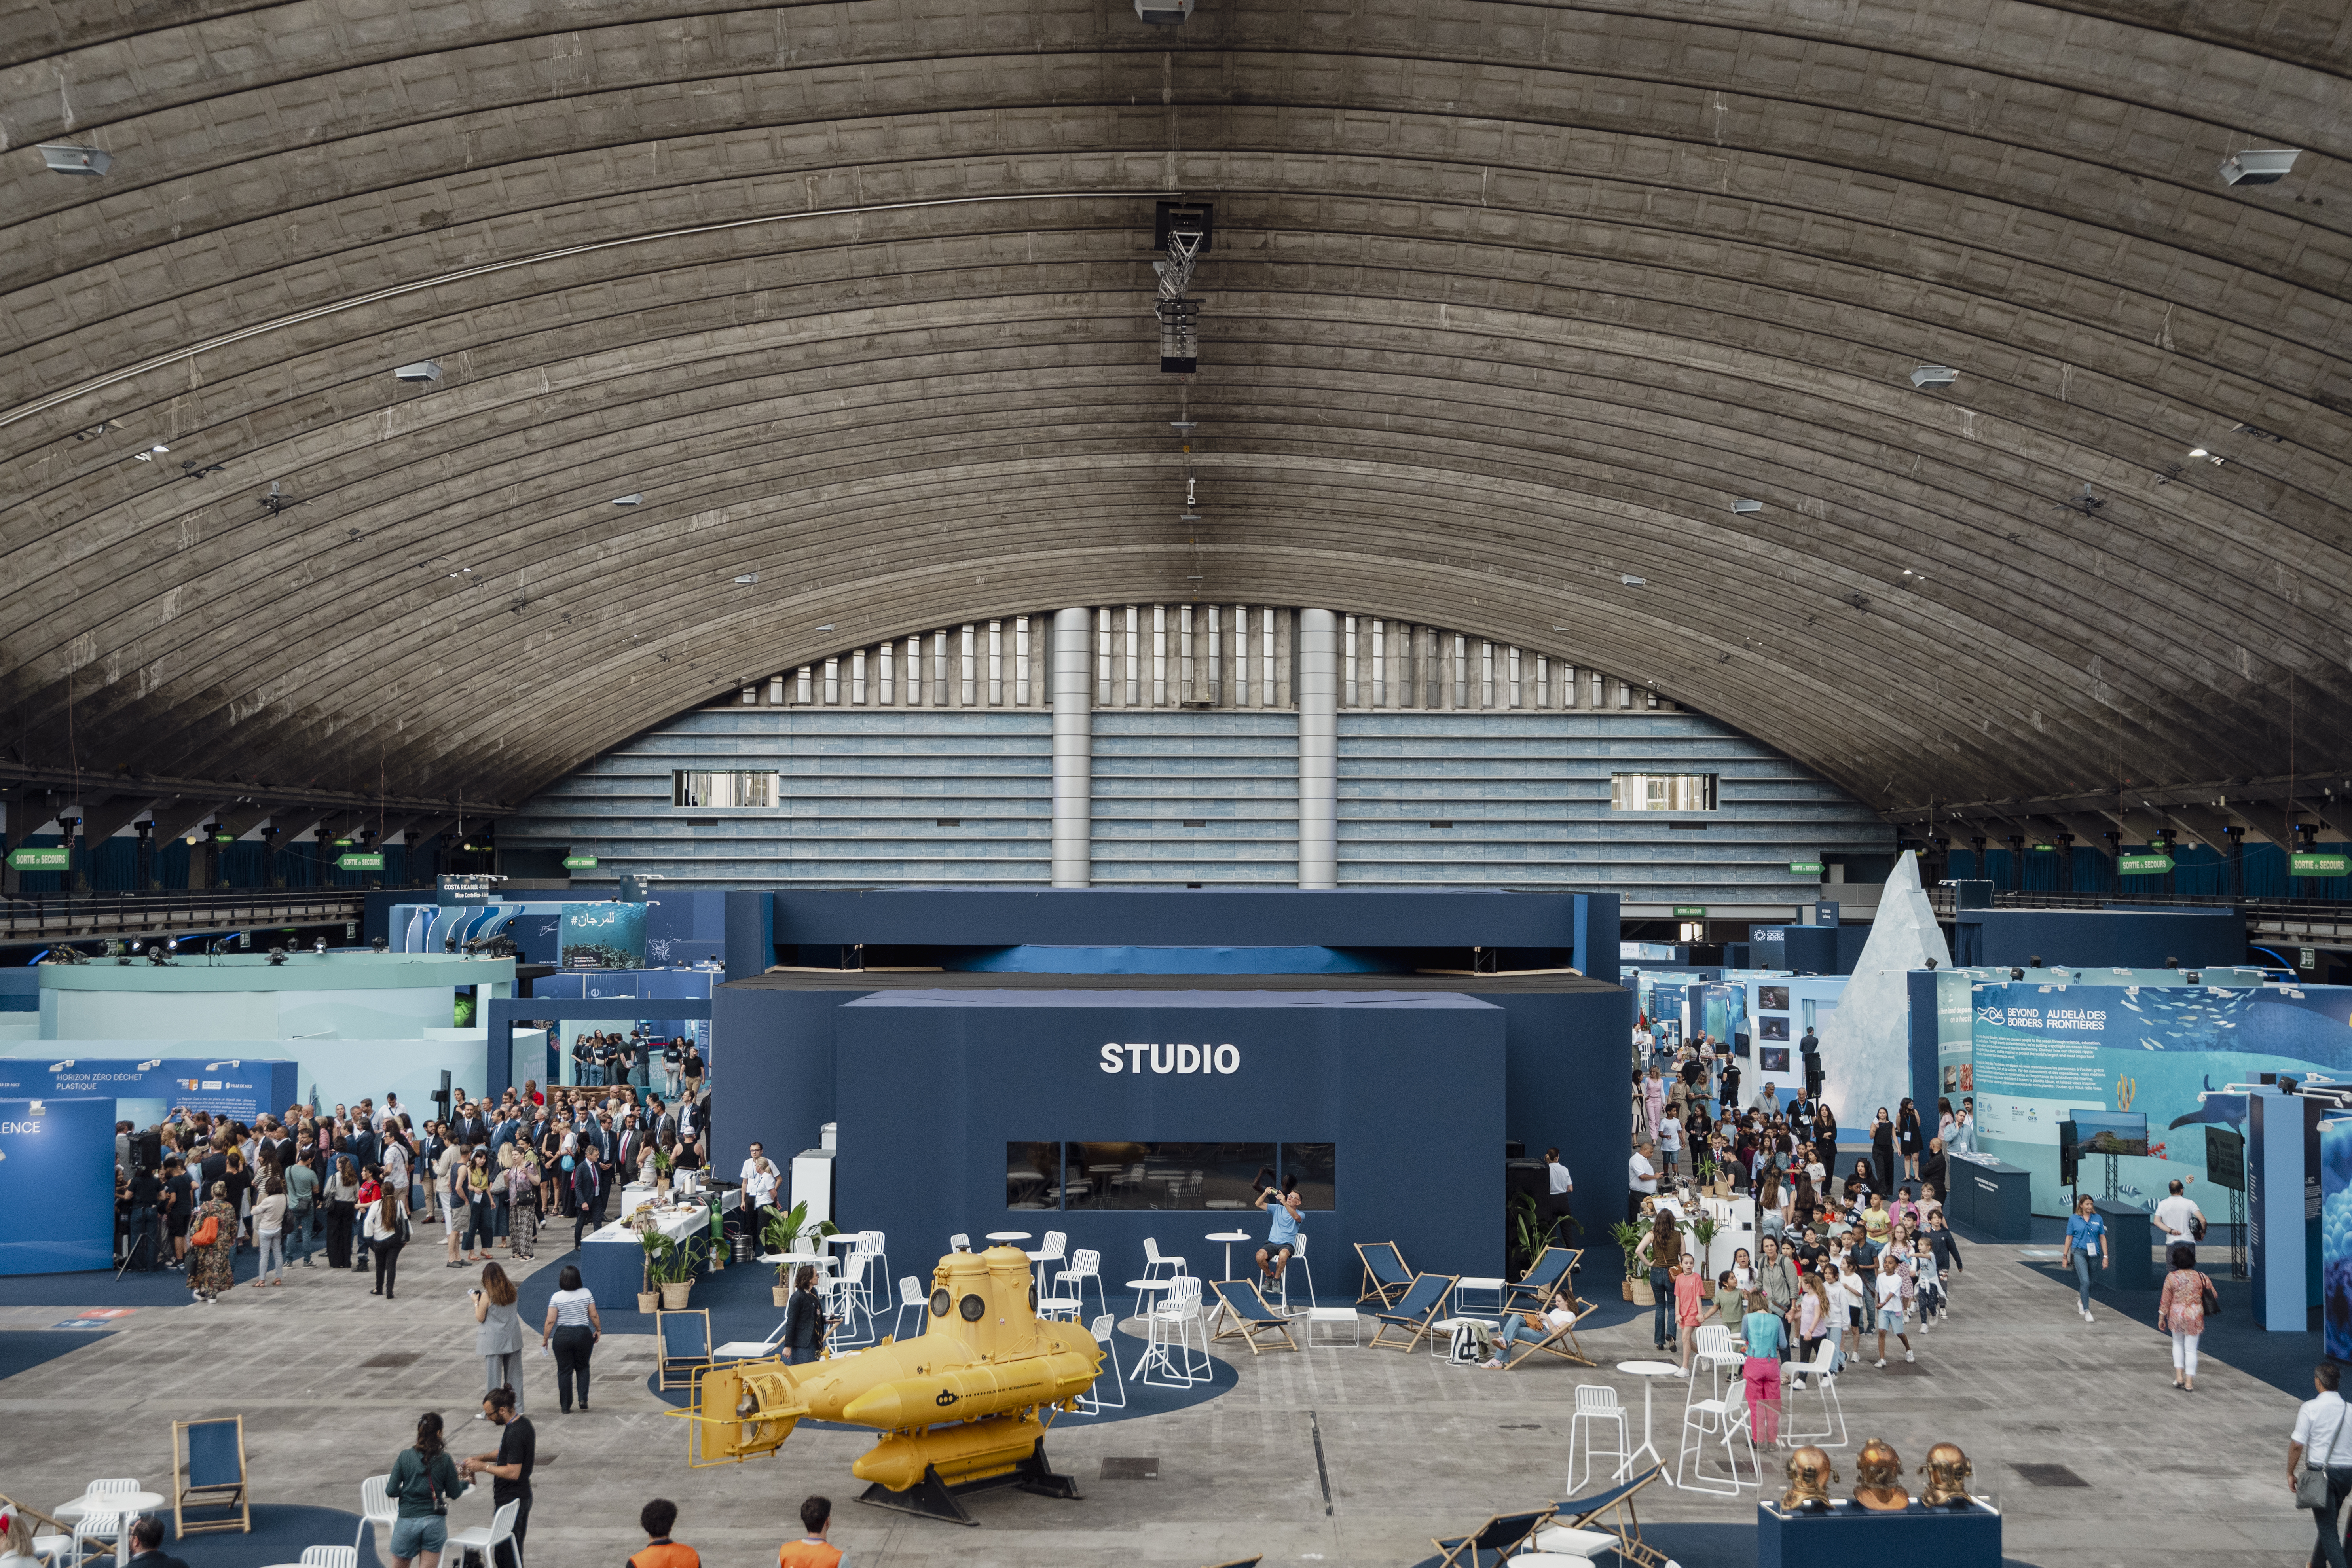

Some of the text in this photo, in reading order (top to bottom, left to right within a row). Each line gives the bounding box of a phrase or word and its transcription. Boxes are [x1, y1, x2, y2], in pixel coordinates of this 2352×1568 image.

[17, 855, 35, 864] SORTIE
[41, 855, 65, 863] SECOURS
[2123, 861, 2139, 870] SORTIE
[2295, 860, 2314, 869] SORTIE
[2320, 860, 2344, 870] SECOURS
[2008, 1008, 2038, 1018] BEYOND
[2047, 1008, 2107, 1020] AU DELÀ DES
[2008, 1018, 2043, 1028] BORDERS
[2047, 1017, 2104, 1030] FRONTIÈRES
[1100, 1043, 1240, 1074] STUDIO
[0, 1121, 41, 1133] ENCE
